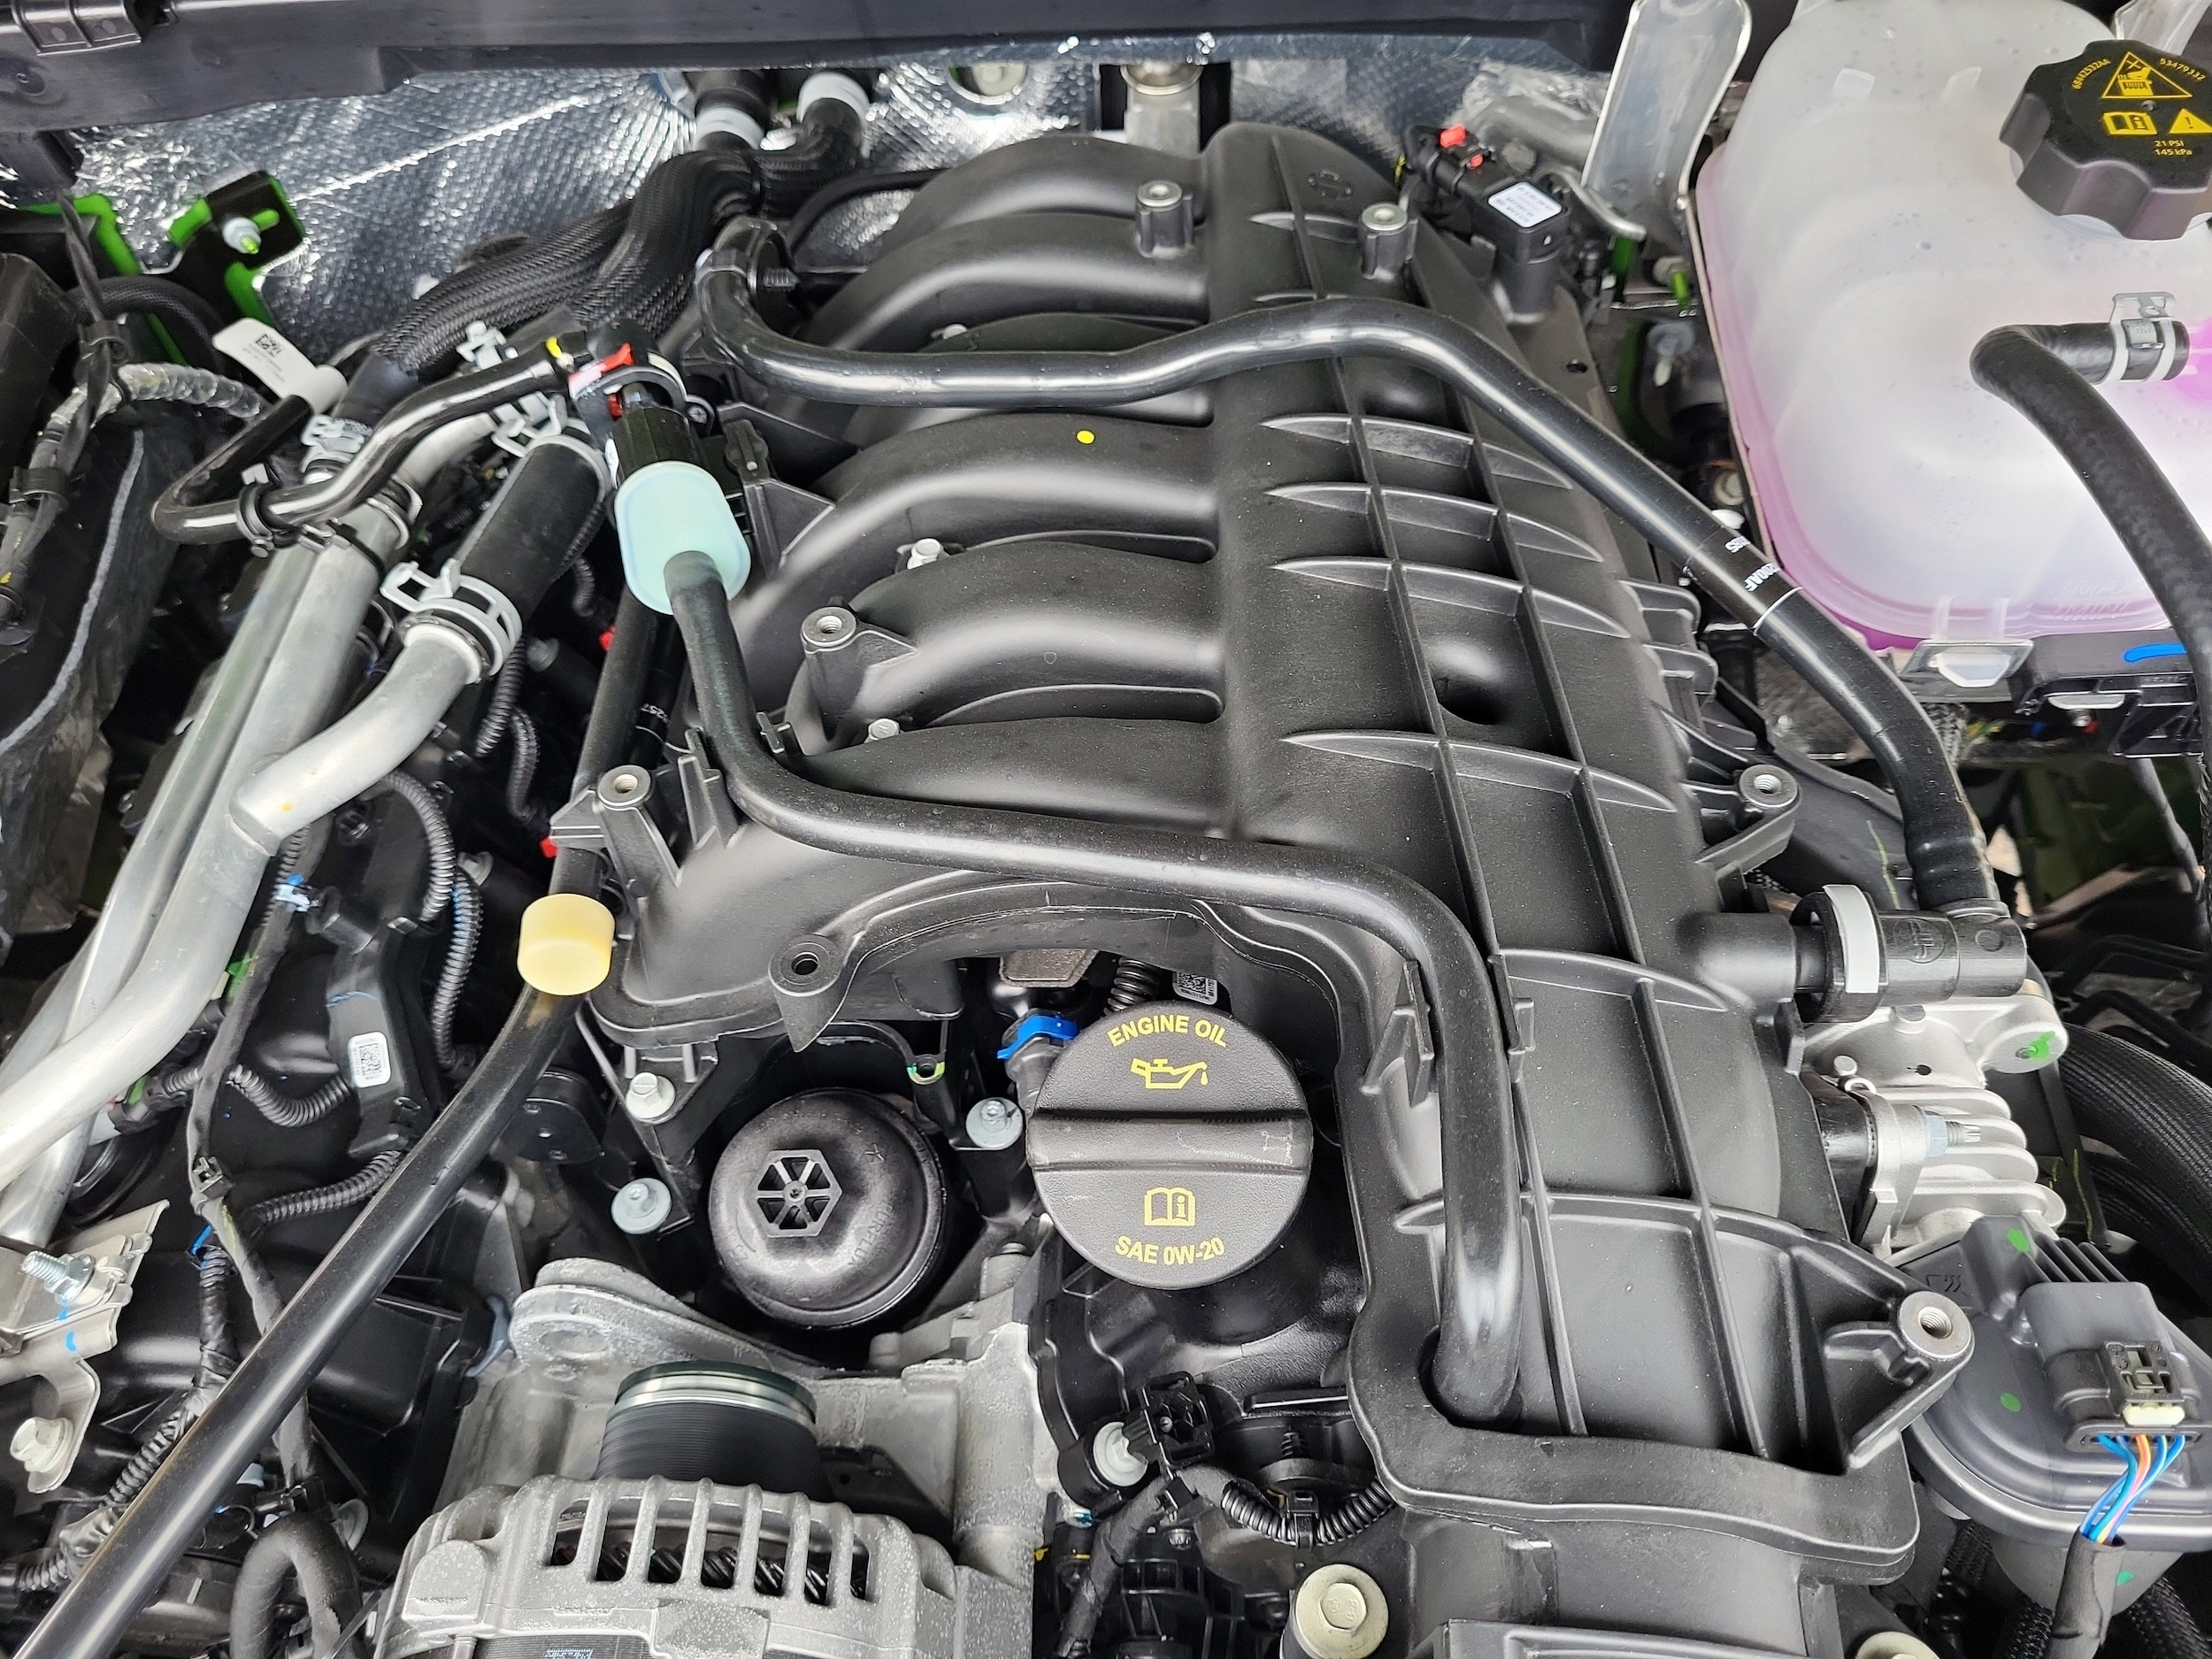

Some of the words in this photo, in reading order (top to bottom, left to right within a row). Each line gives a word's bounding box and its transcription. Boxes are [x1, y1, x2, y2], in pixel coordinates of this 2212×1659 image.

[2159, 58, 2207, 81] 53479332
[1107, 1015, 1190, 1048] ENGINE
[1194, 1019, 1227, 1048] OIL
[1115, 1235, 1159, 1264] SAE
[1164, 1236, 1225, 1265] 0W-20
